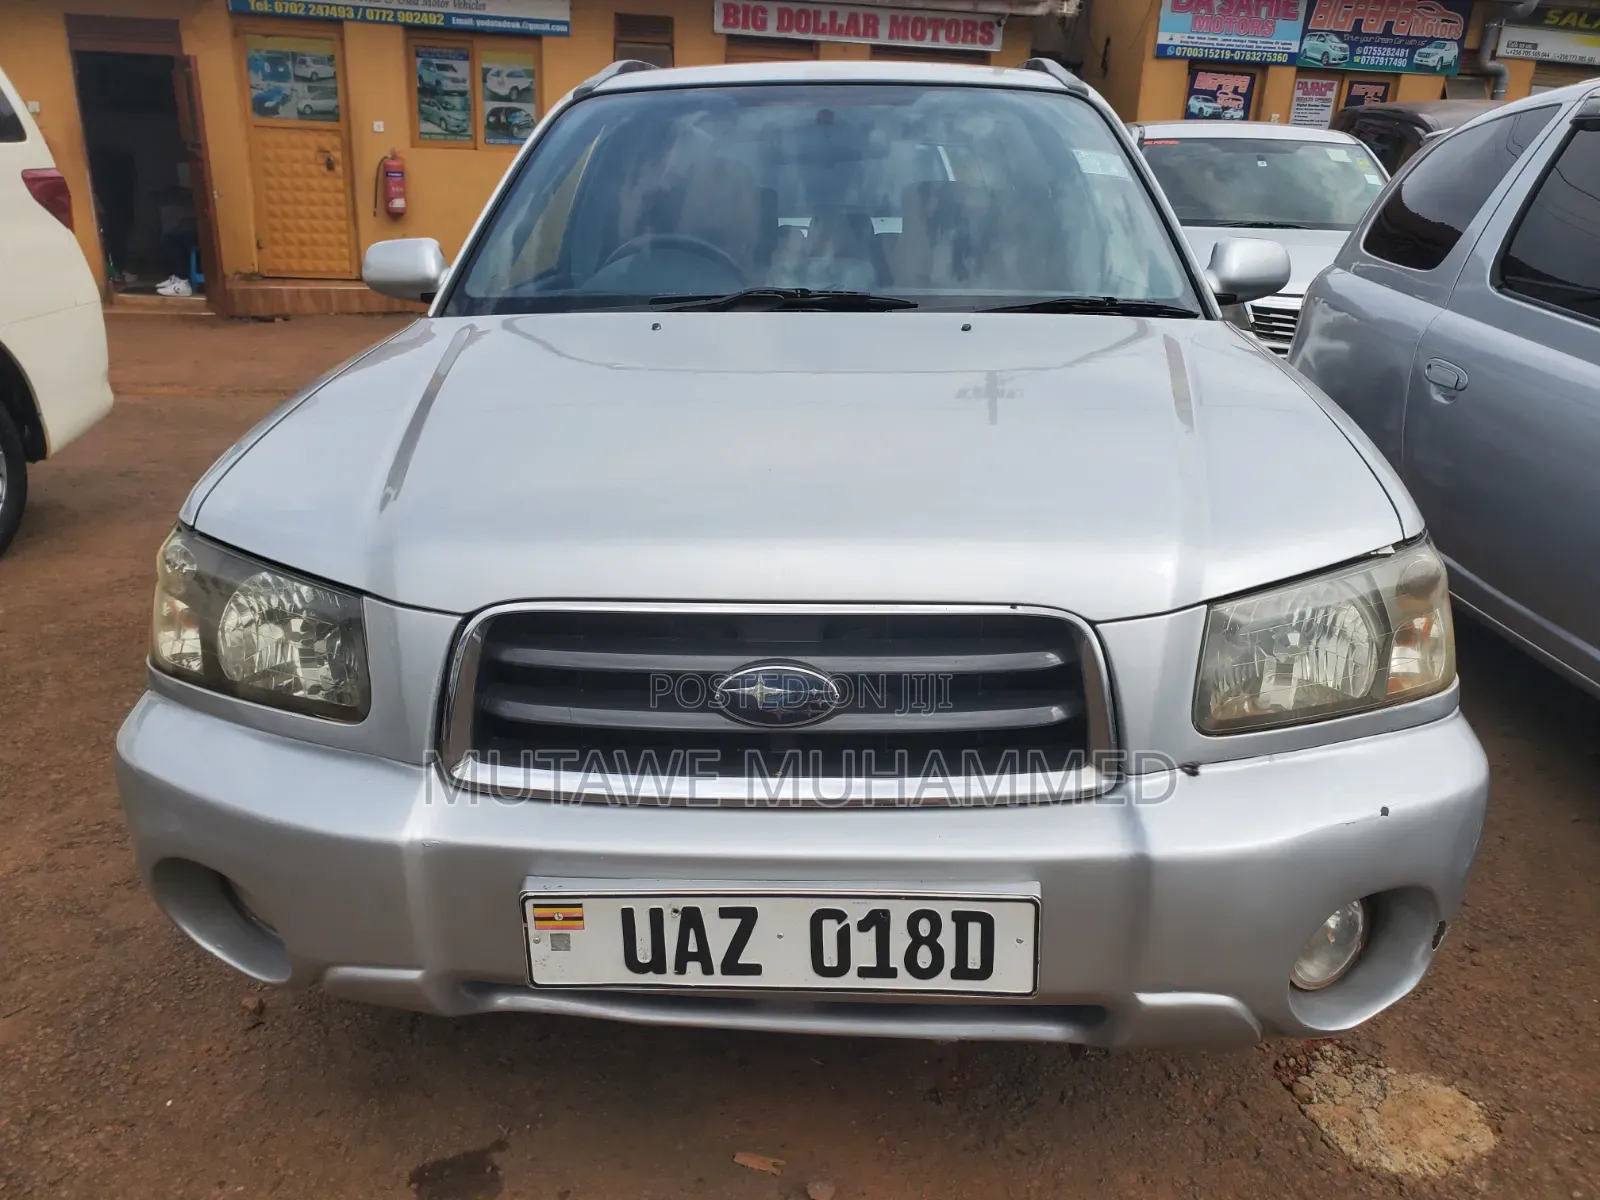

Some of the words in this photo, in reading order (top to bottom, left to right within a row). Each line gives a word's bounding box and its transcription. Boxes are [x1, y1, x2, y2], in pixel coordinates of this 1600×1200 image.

[249, 0, 273, 12] Tel:
[274, 0, 306, 15] 0702
[309, 3, 354, 19] 247493
[365, 8, 394, 21] 0772
[397, 11, 445, 26] 902492
[453, 0, 487, 11] Vehicles
[721, 2, 768, 32] BIG
[776, 6, 881, 40] DOLLAR
[887, 14, 996, 46] MOTORS
[1190, 13, 1277, 38] MOTORS
[1409, 16, 1464, 41] Motors
[1175, 45, 1289, 63] 0700315219-0783275360
[1360, 55, 1408, 68] 0787917490
[1363, 45, 1410, 58] 0755282481
[620, 905, 763, 976] UAZ
[809, 908, 996, 981] 018D
